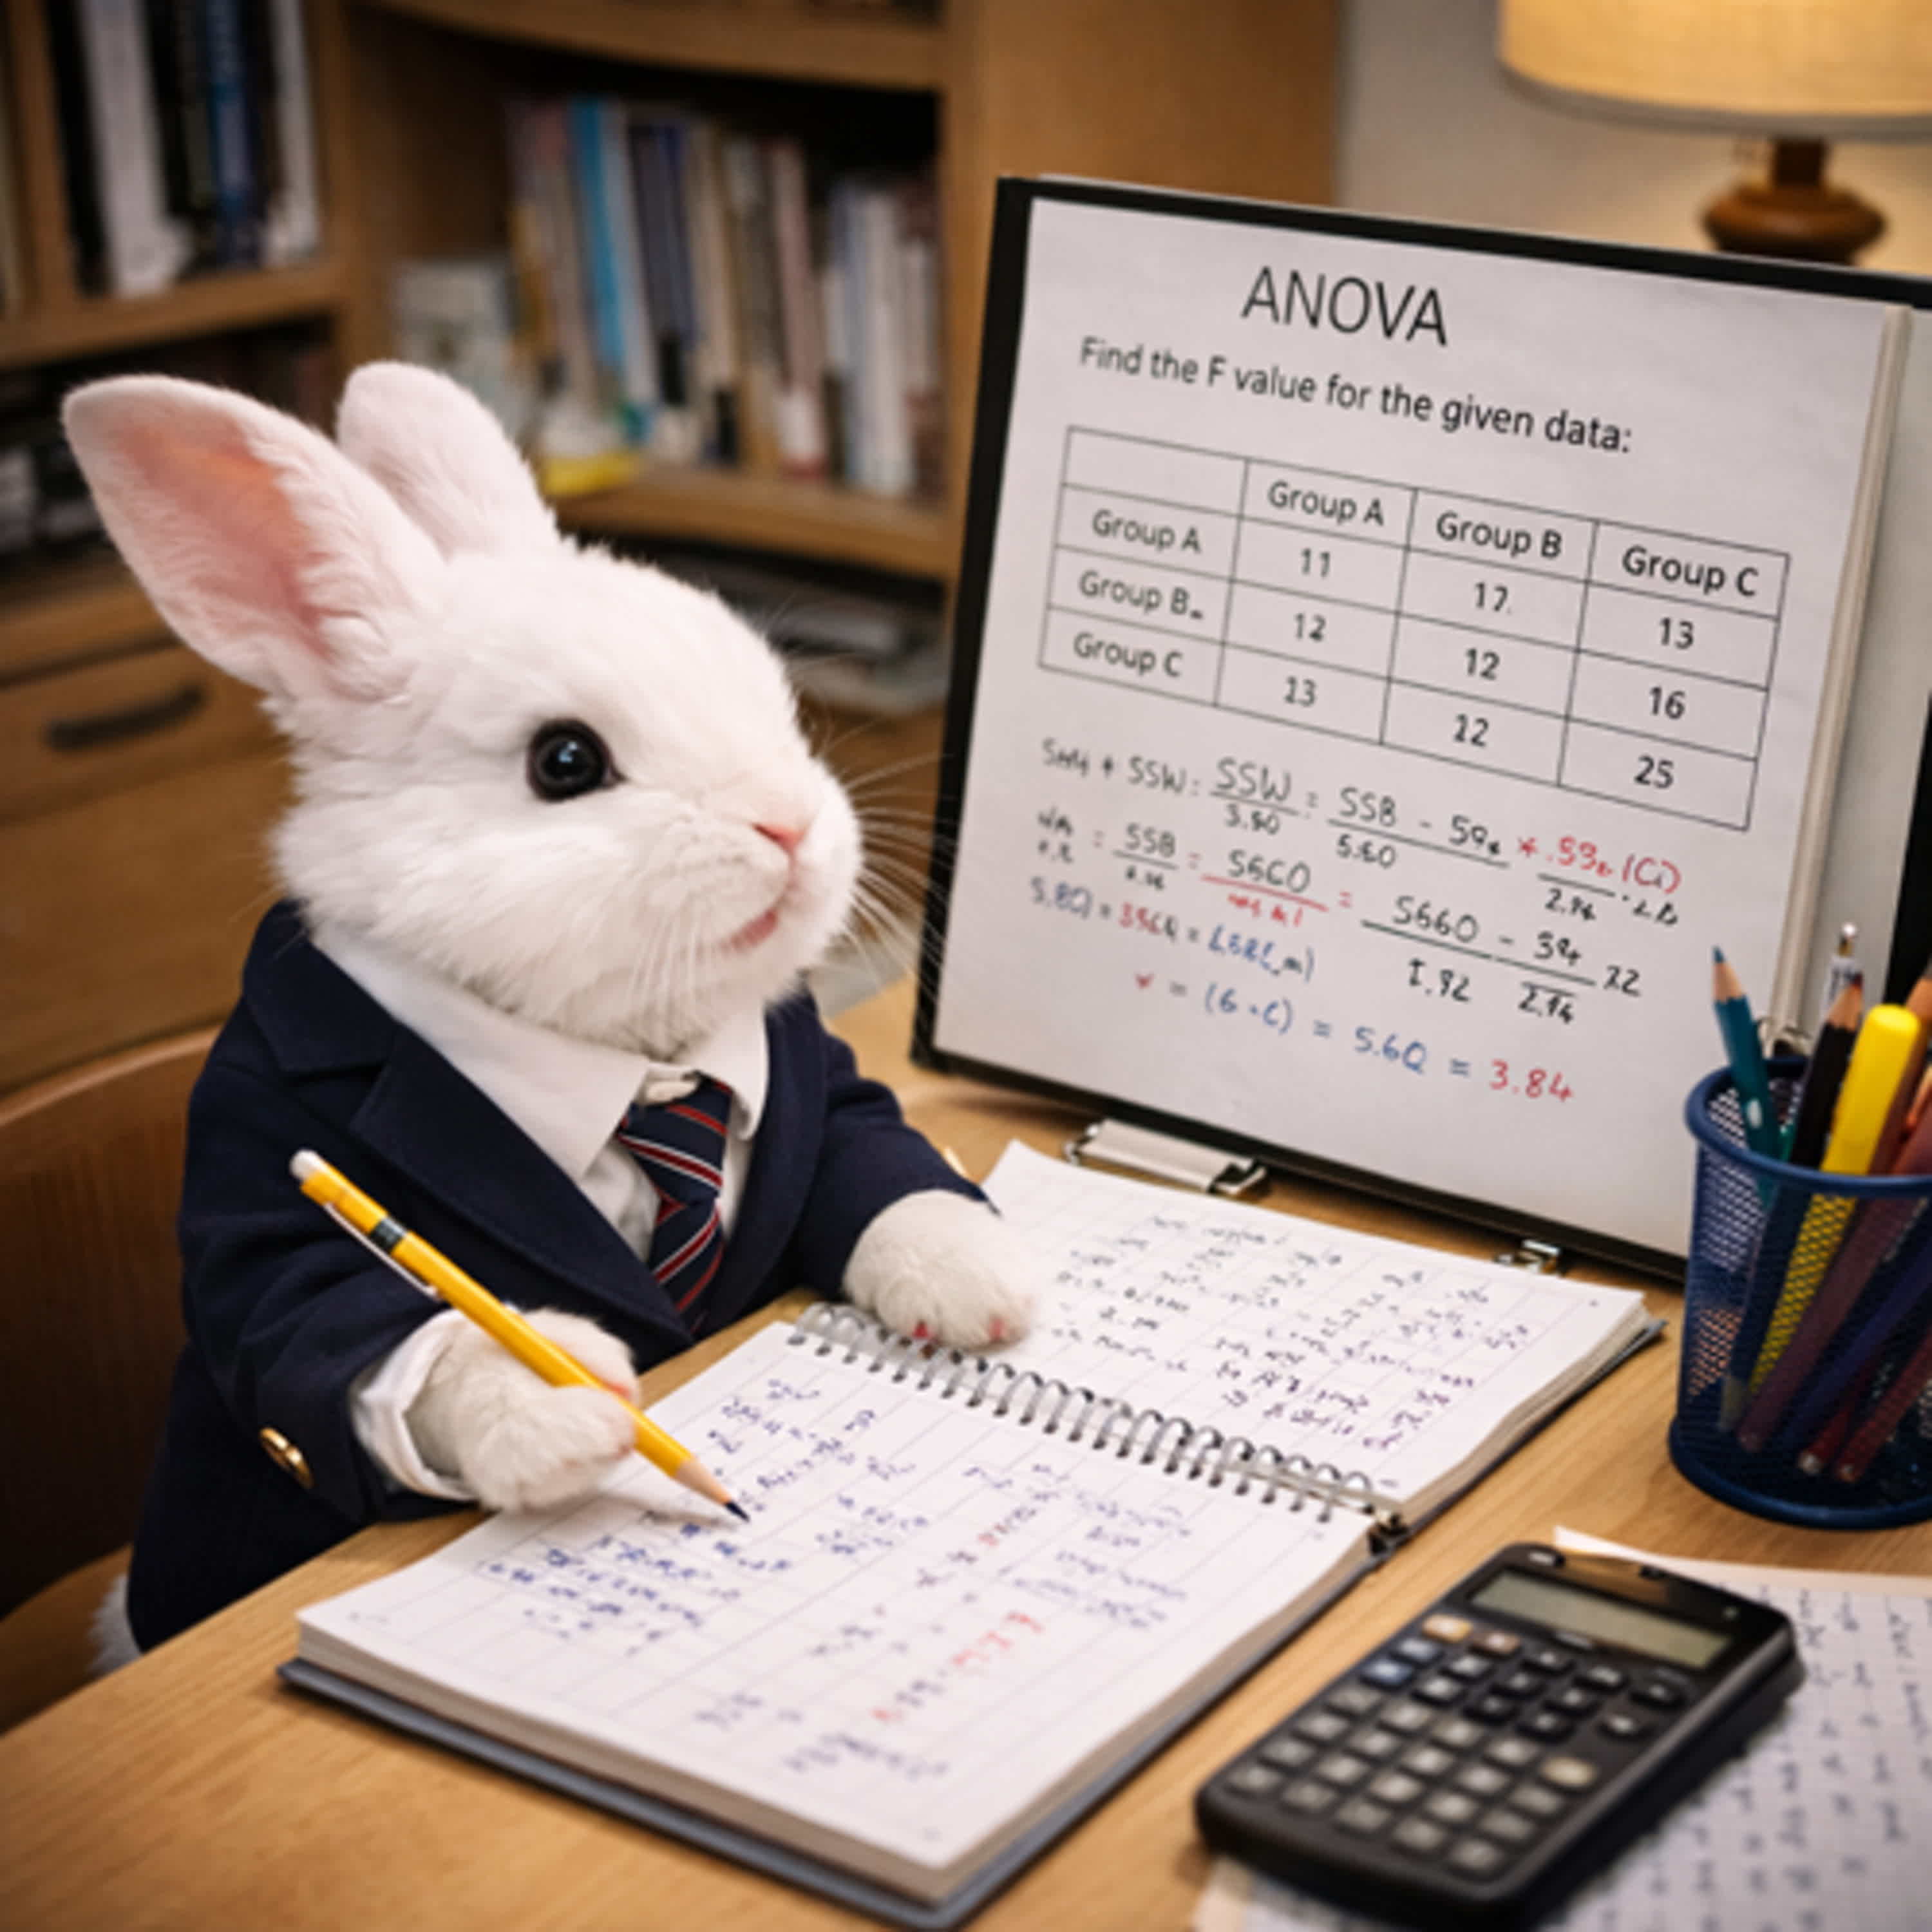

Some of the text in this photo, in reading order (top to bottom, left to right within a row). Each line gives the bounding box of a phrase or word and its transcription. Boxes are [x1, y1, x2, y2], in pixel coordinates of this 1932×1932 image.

[1240, 266, 1449, 346] ANOVA
[1079, 336, 1633, 453] Find the F value for the given data:
[1268, 479, 1384, 526] Group A
[1092, 509, 1202, 554] Group A
[1435, 511, 1562, 559] Group B
[1300, 547, 1331, 578] 11
[1622, 545, 1759, 597] Group C
[1078, 570, 1163, 612] Group
[1294, 613, 1326, 643] 12
[1659, 618, 1694, 650] 13
[1073, 632, 1182, 678] Group C
[1465, 649, 1500, 680] 12
[1649, 687, 1685, 720] 16
[1634, 755, 1674, 789] 25
[1490, 1058, 1575, 1103] 3.84
